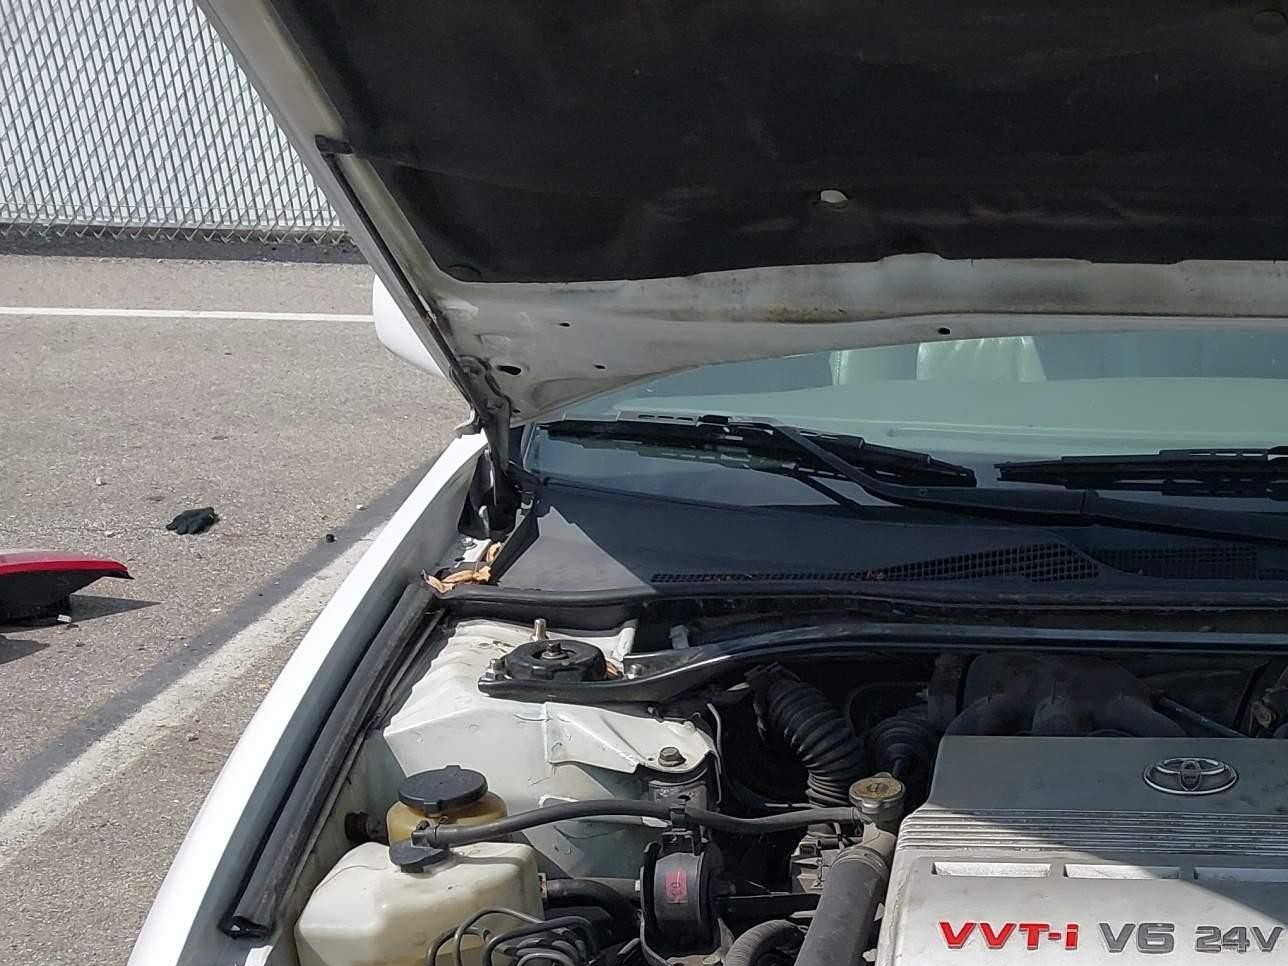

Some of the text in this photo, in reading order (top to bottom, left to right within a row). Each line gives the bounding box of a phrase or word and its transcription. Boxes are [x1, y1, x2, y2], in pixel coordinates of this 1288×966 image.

[938, 922, 1285, 954] VVT-i V6 24V
